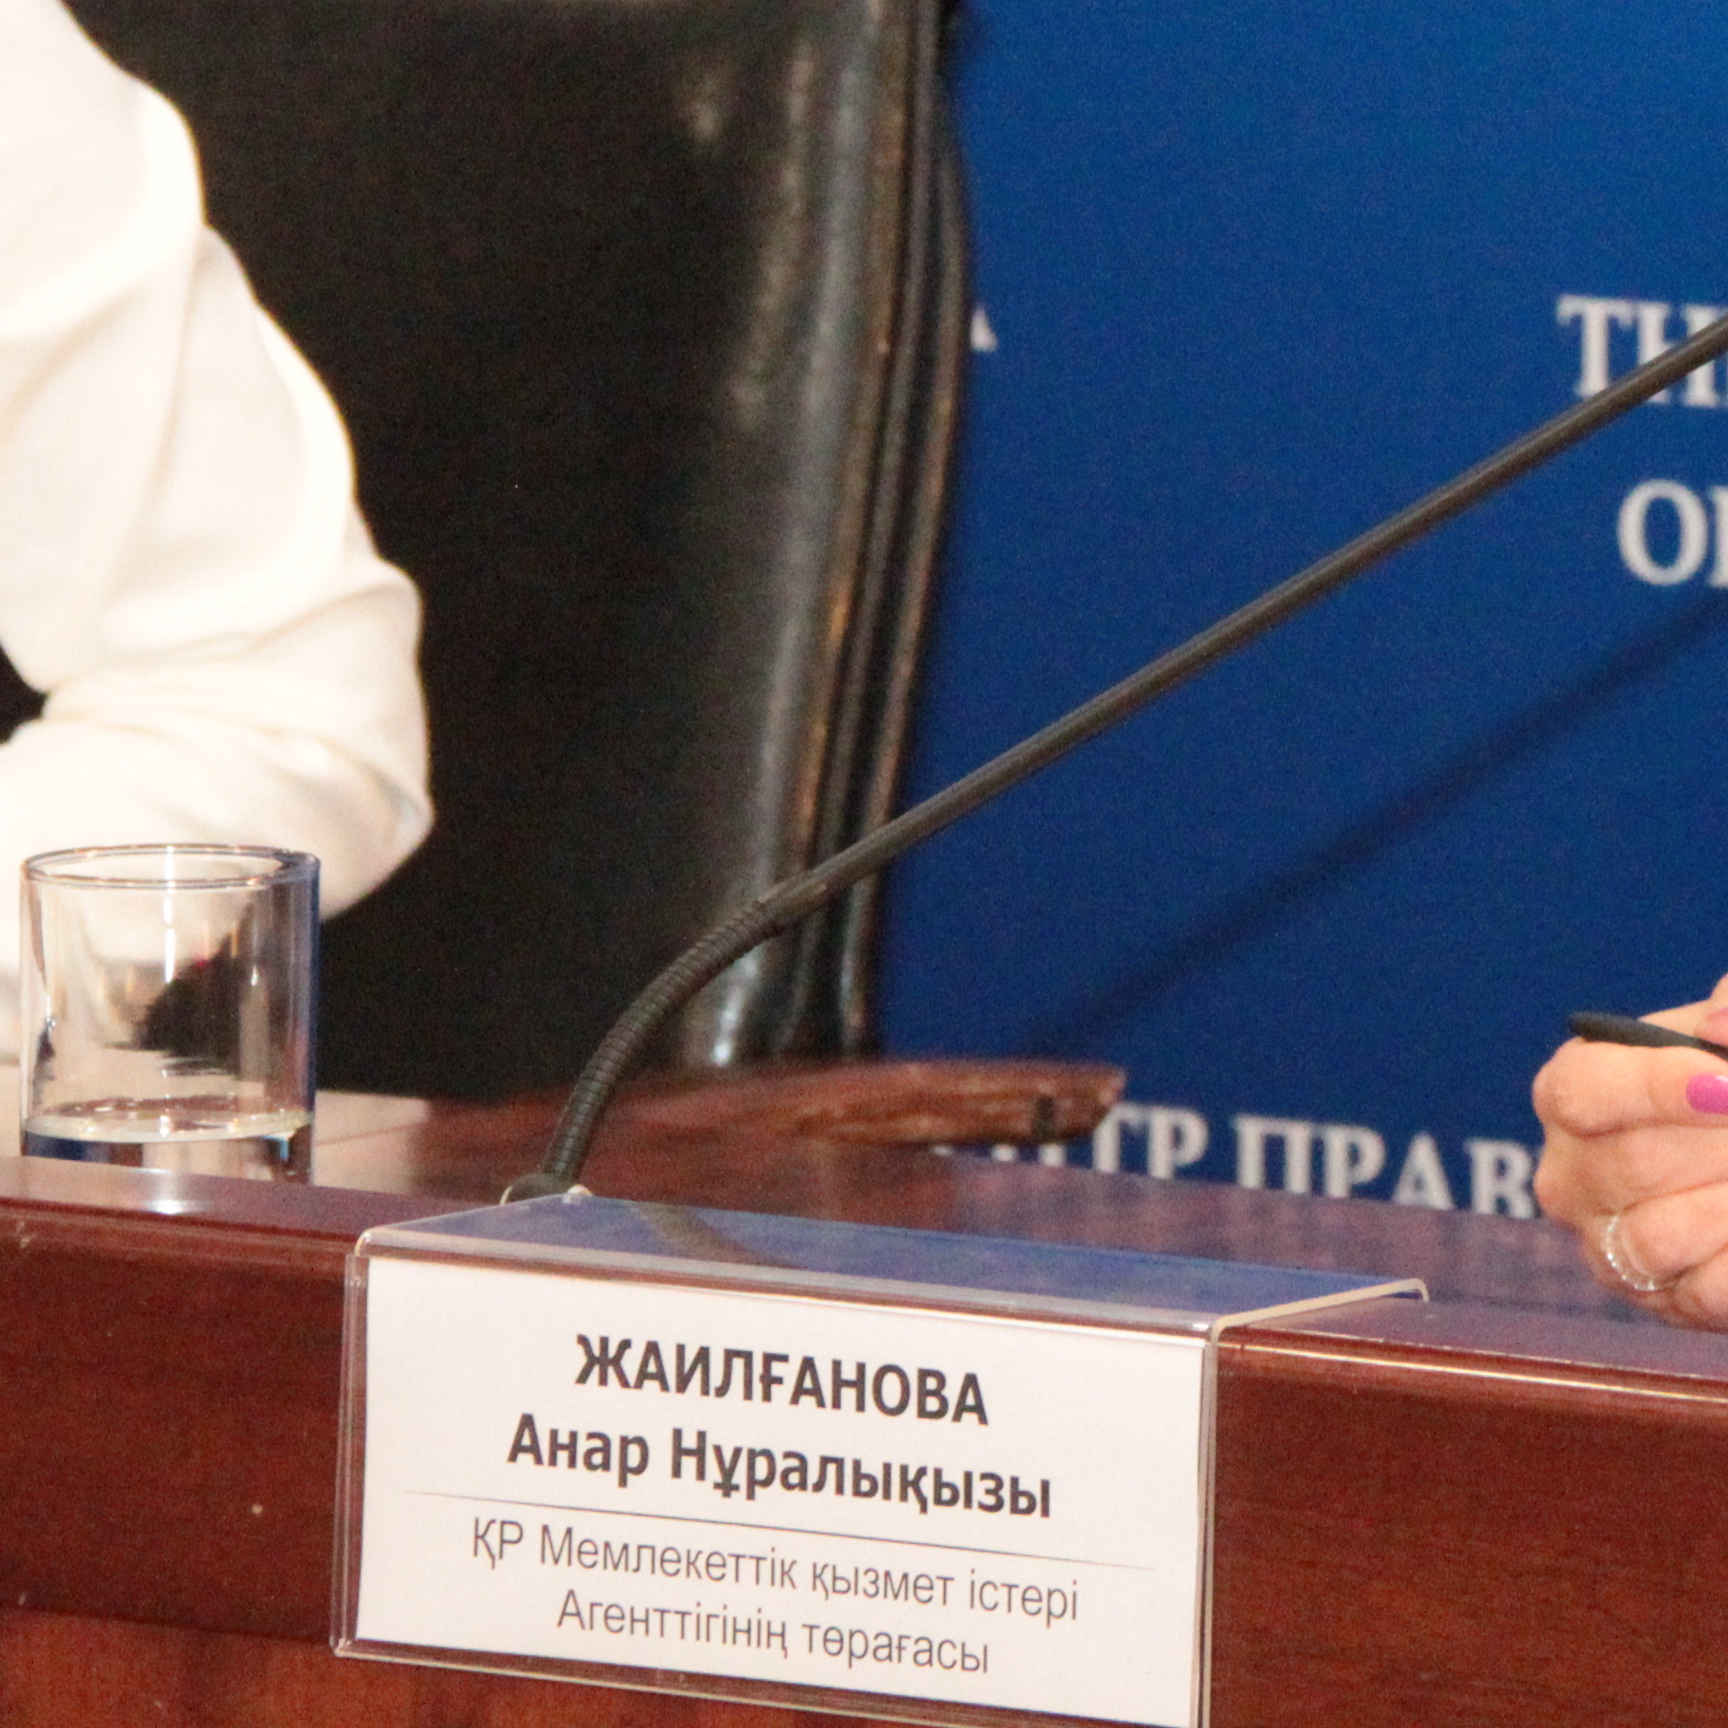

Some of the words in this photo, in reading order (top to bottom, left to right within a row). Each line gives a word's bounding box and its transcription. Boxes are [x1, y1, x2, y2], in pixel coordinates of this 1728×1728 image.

[574, 1333, 989, 1427] ЖАИЛҒАНОВА
[506, 1412, 650, 1489] Анар
[670, 1427, 1052, 1520] Нұралықызы
[472, 1517, 524, 1570] ҚР
[540, 1523, 798, 1590] Мемлекеттік
[811, 1561, 955, 1606] қызмет
[968, 1567, 1078, 1629] істері
[556, 1588, 789, 1660] Агенттігінің
[801, 1622, 989, 1675] төрағасы
